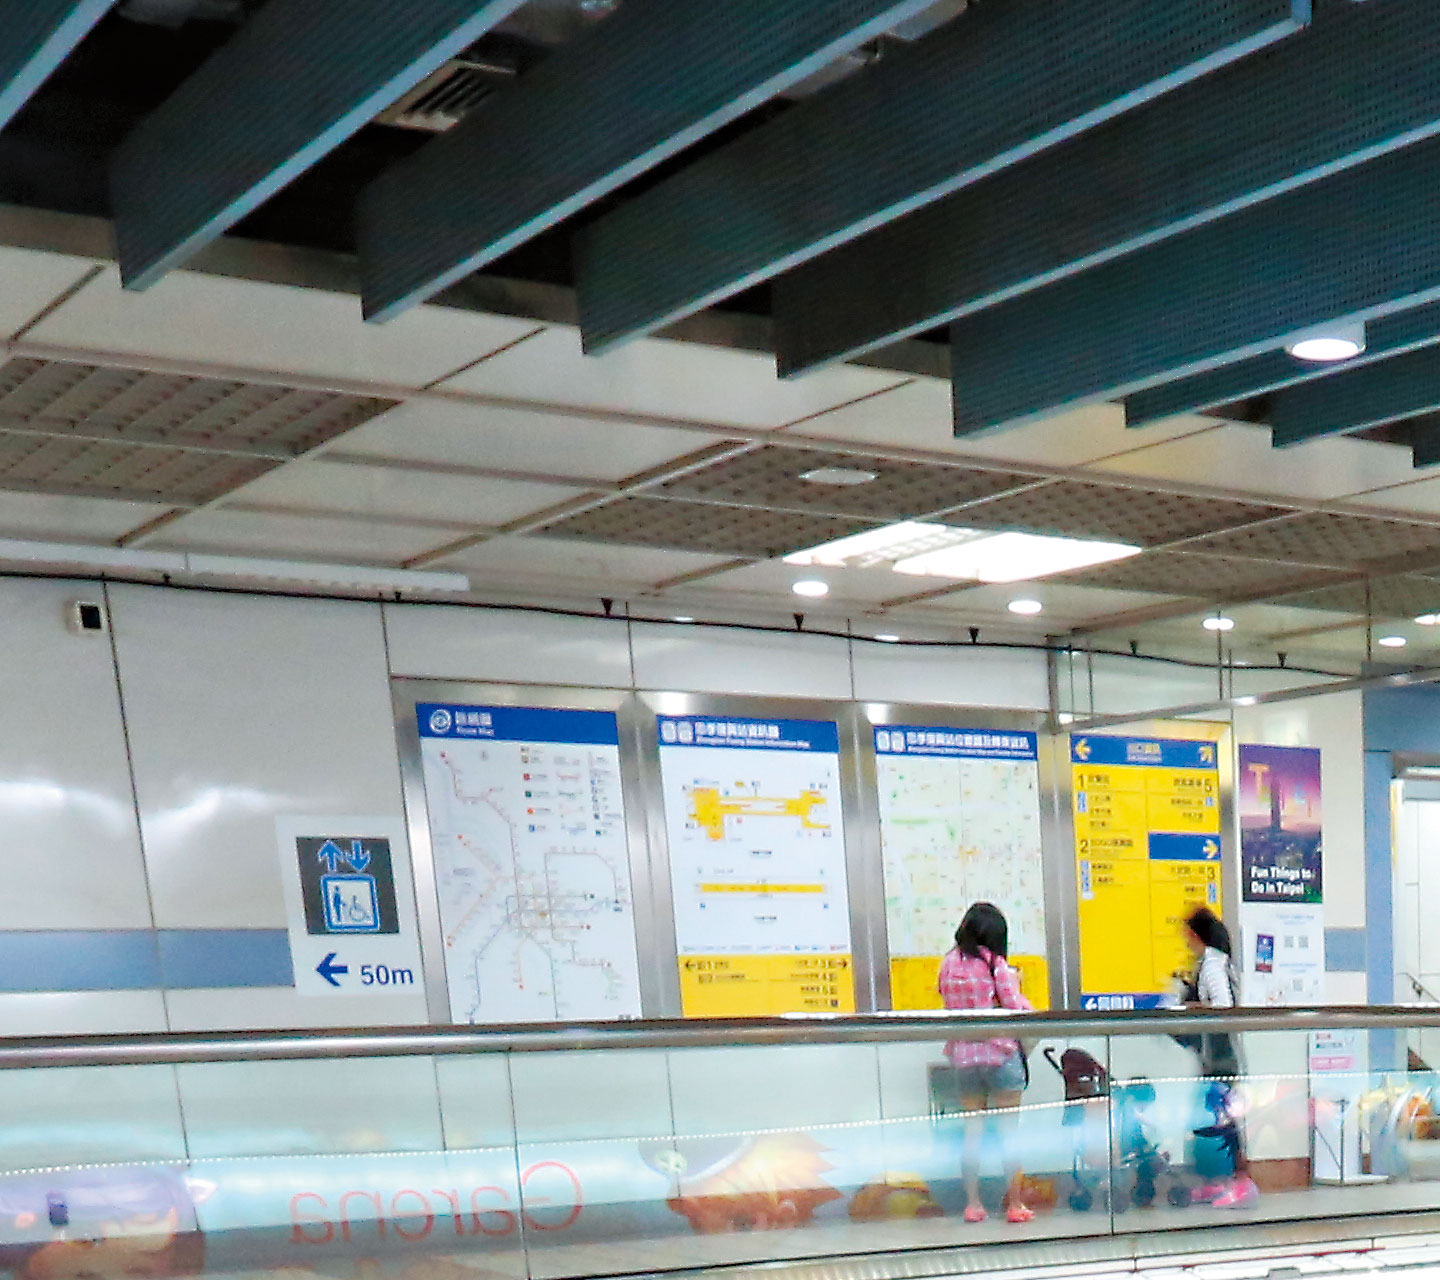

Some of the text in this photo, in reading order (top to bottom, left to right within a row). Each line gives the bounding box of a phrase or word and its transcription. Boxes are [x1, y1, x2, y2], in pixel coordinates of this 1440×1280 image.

[1269, 866, 1300, 881] Things
[1276, 882, 1305, 896] Taipei
[360, 965, 414, 985] 50m
